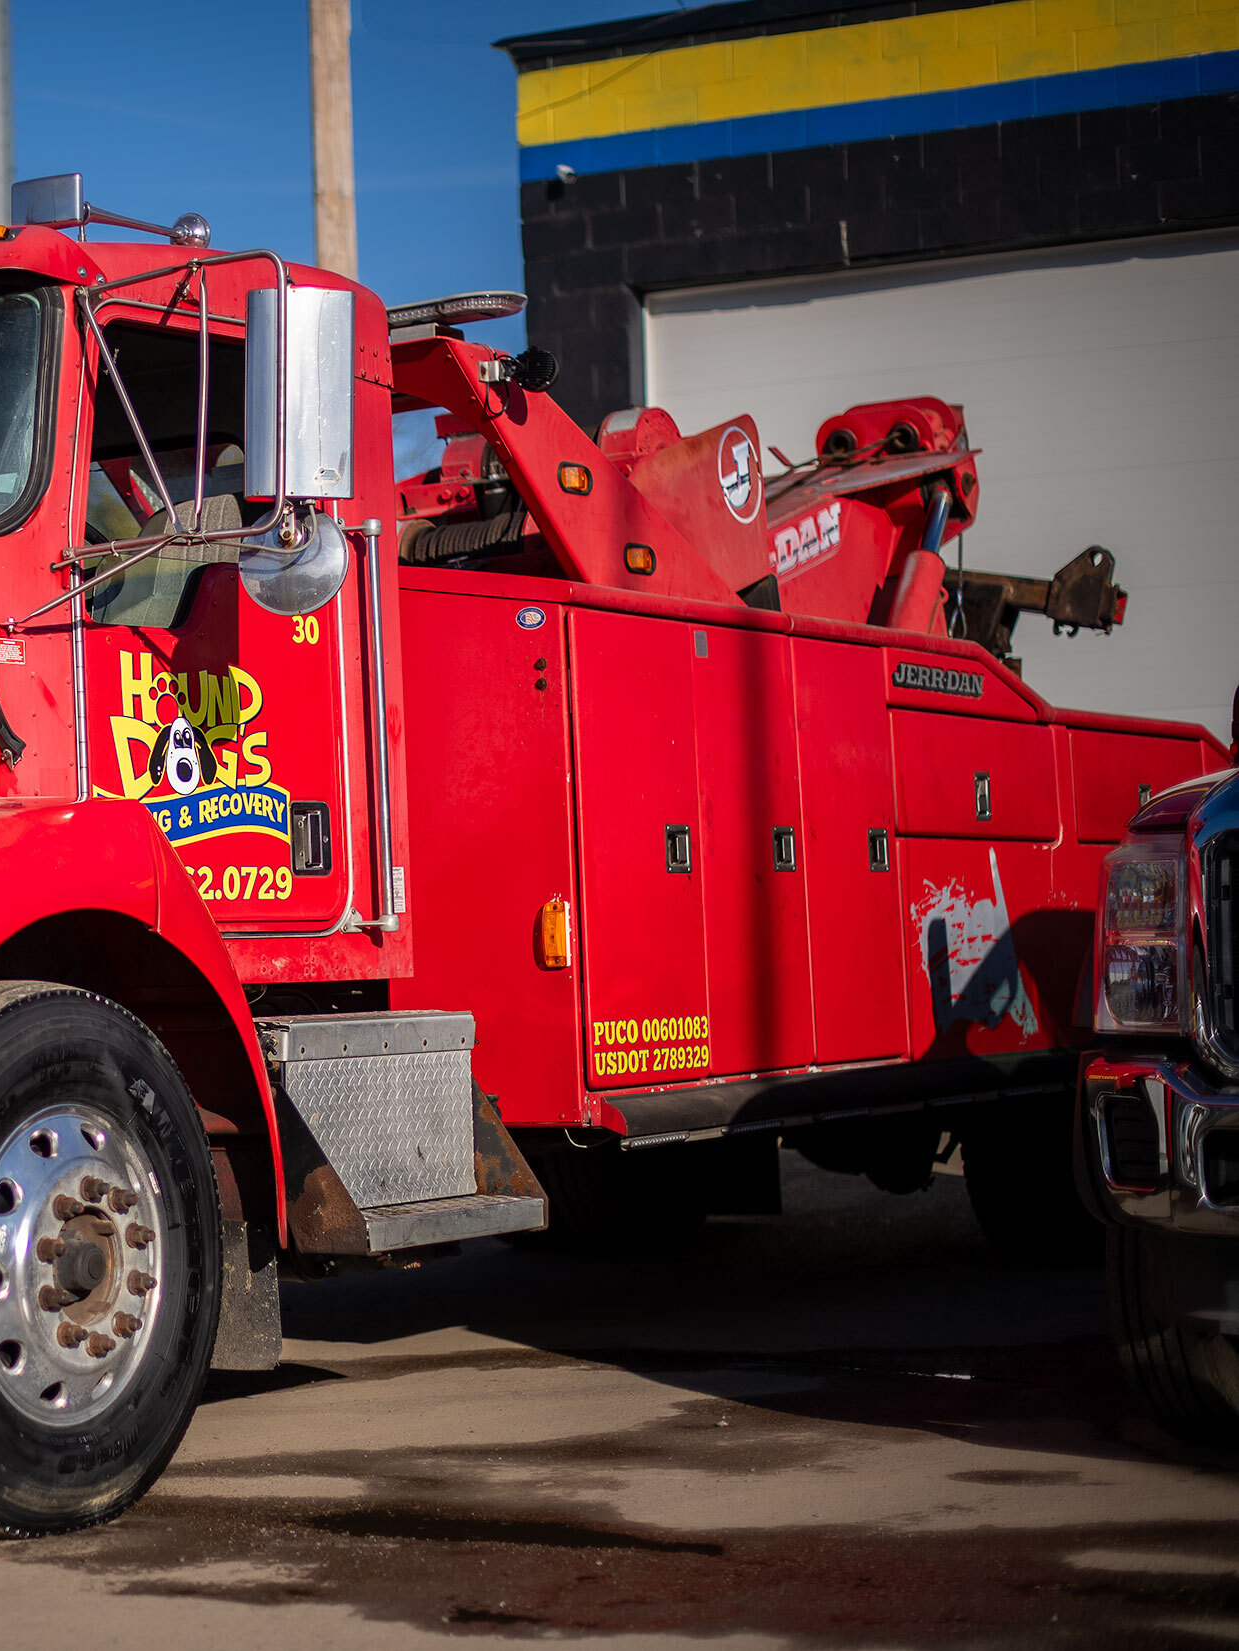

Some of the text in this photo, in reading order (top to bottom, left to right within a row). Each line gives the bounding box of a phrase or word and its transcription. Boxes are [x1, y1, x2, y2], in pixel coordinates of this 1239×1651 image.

[292, 615, 319, 644] 30
[119, 650, 263, 728] HOUND
[178, 805, 193, 829] &
[198, 792, 285, 823] RECOVERY
[184, 865, 293, 900] 2.0729
[593, 1015, 708, 1046] PUCO 00601083
[594, 1044, 709, 1076] USDOT 2789329
